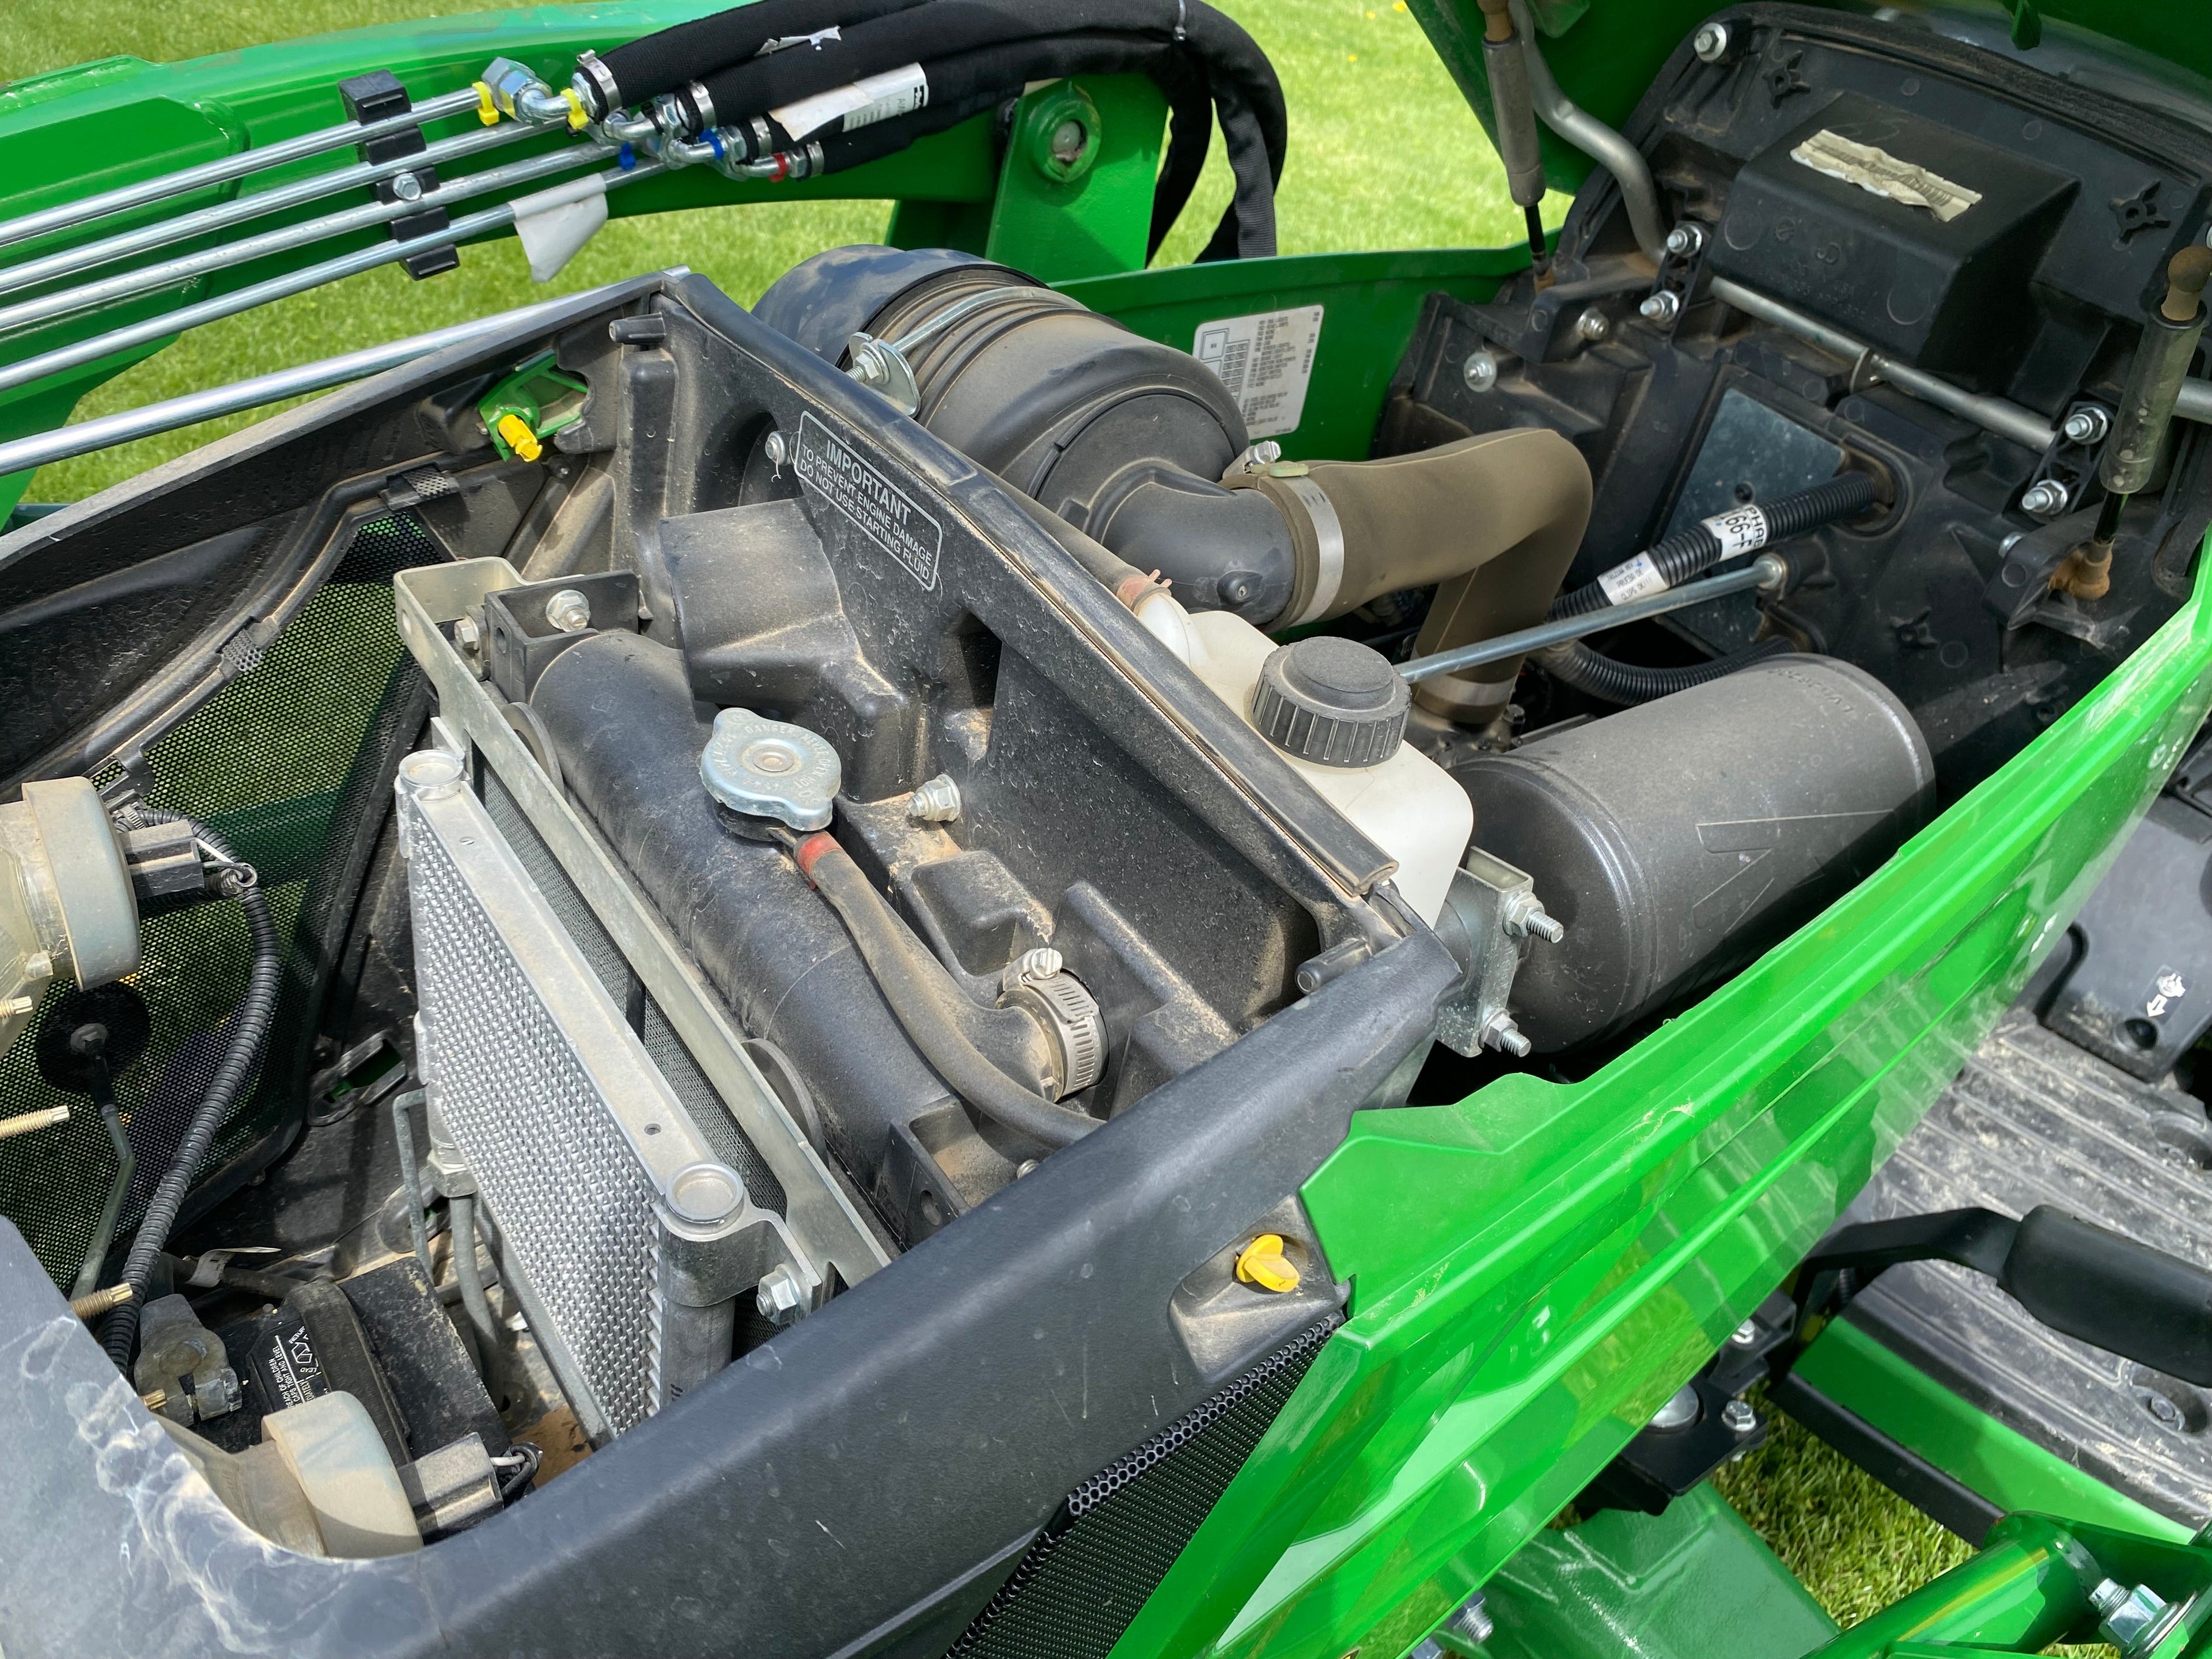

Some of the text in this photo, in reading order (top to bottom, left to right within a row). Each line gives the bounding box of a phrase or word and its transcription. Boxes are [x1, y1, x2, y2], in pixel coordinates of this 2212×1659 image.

[803, 444, 932, 566] TO PREVENT ENGINE DAMAGE
[827, 440, 911, 525] IMPORTANT
[800, 459, 929, 580] DO NOT USE STARTING FLUID
[800, 733, 829, 756] NEVER
[812, 759, 831, 777] OPEN
[268, 1358, 294, 1408] REACH OF CHILDREN
[272, 1346, 300, 1402] CAPS TIGHT AND LEVEL
